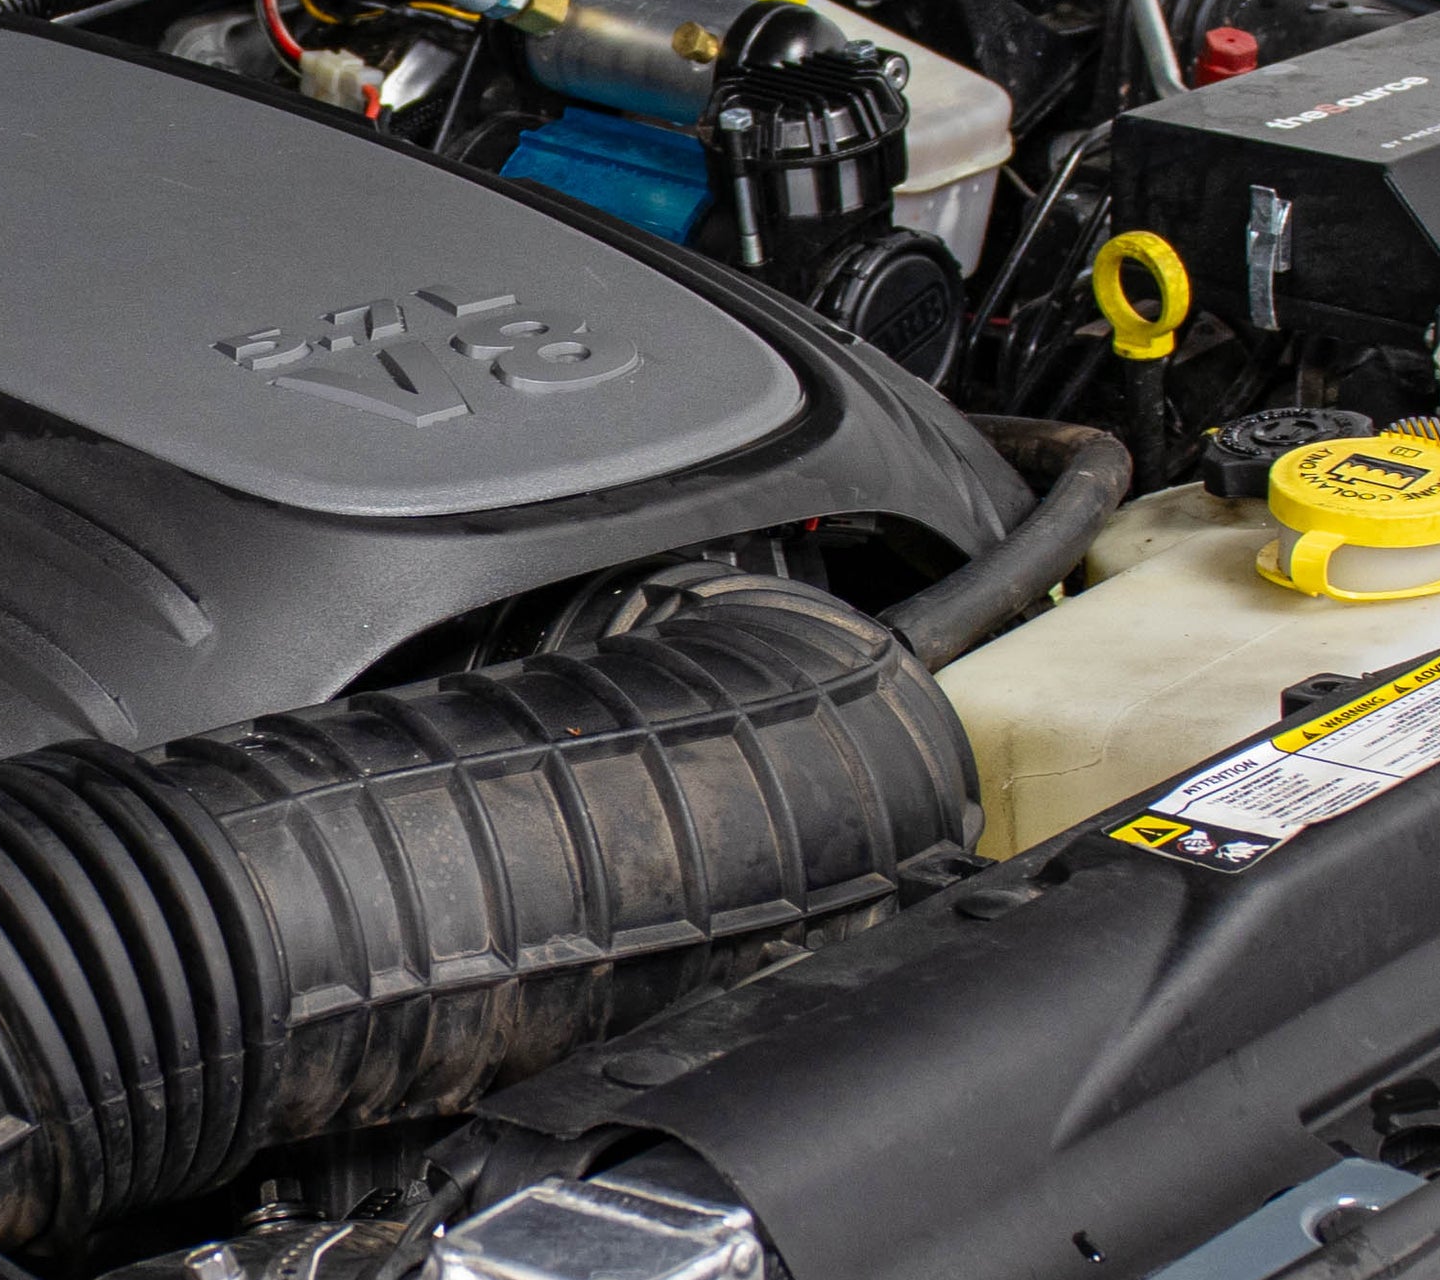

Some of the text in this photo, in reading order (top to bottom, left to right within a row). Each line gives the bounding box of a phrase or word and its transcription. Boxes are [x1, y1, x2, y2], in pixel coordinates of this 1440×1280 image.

[267, 318, 645, 428] V8
[1303, 447, 1337, 471] ONLY
[1300, 471, 1394, 502] COOLANT
[1321, 696, 1387, 730] WARNING
[1182, 758, 1259, 796] ATTENTION
